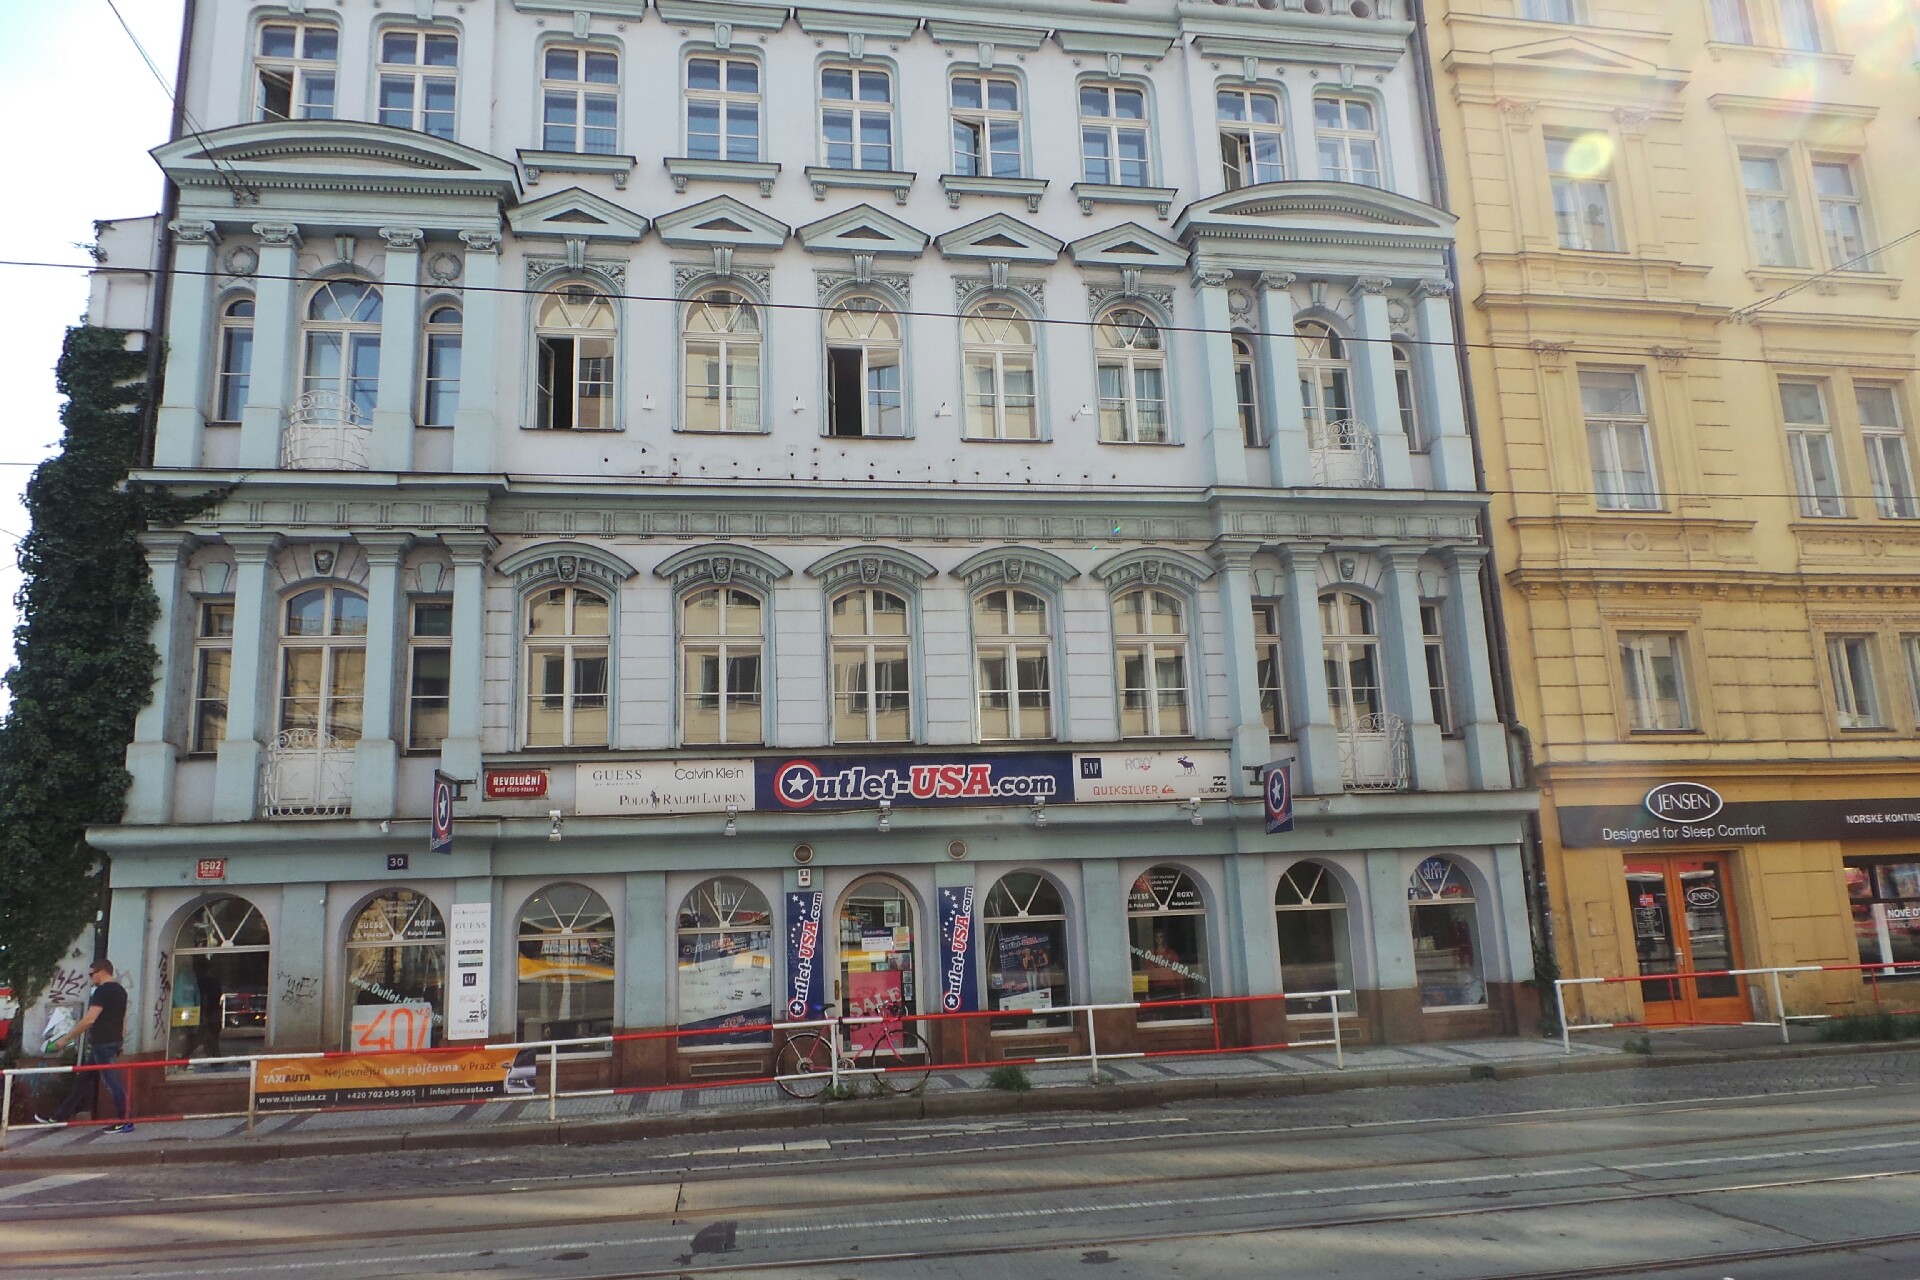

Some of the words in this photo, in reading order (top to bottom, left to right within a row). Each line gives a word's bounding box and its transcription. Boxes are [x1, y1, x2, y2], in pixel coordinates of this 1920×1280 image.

[592, 769, 642, 781] GUESS
[674, 768, 714, 780] Calvin
[715, 767, 744, 779] Klein
[1084, 763, 1100, 775] GAP
[493, 774, 541, 786] REVOLUČNÍ
[774, 759, 1057, 808] Outlet-USA.com
[1093, 785, 1158, 796] QUIKSILVER
[619, 794, 648, 806] POLO
[663, 794, 700, 805] RALPH
[703, 793, 746, 804] LAUREN
[1657, 793, 1712, 813] JENSEN
[1846, 812, 1883, 824] NORSKÉ
[1602, 827, 1660, 843] Designed
[1662, 827, 1680, 839] for
[1681, 825, 1716, 840] Sleep
[1718, 824, 1767, 837] Comfort
[200, 860, 221, 870] 1502
[390, 857, 404, 867] 30
[1691, 892, 1715, 901] JENSEN
[1887, 907, 1911, 918] NOVÉ
[787, 892, 823, 1019] Outlet-USA.com
[943, 886, 974, 1013] Outlet-USA.com
[263, 1074, 311, 1084] TAXIAUTA
[325, 1067, 380, 1078] Nejlevnější
[384, 1065, 406, 1075] taxi
[407, 1063, 459, 1076] půjčovna
[469, 1061, 497, 1071] Praze
[259, 1093, 327, 1104] www.taxiauta.cz
[347, 1091, 367, 1100] +420
[367, 1090, 383, 1098] 702
[384, 1089, 400, 1098] 045
[401, 1088, 416, 1097] 905
[429, 1085, 494, 1096] info@taxiauta.cz
